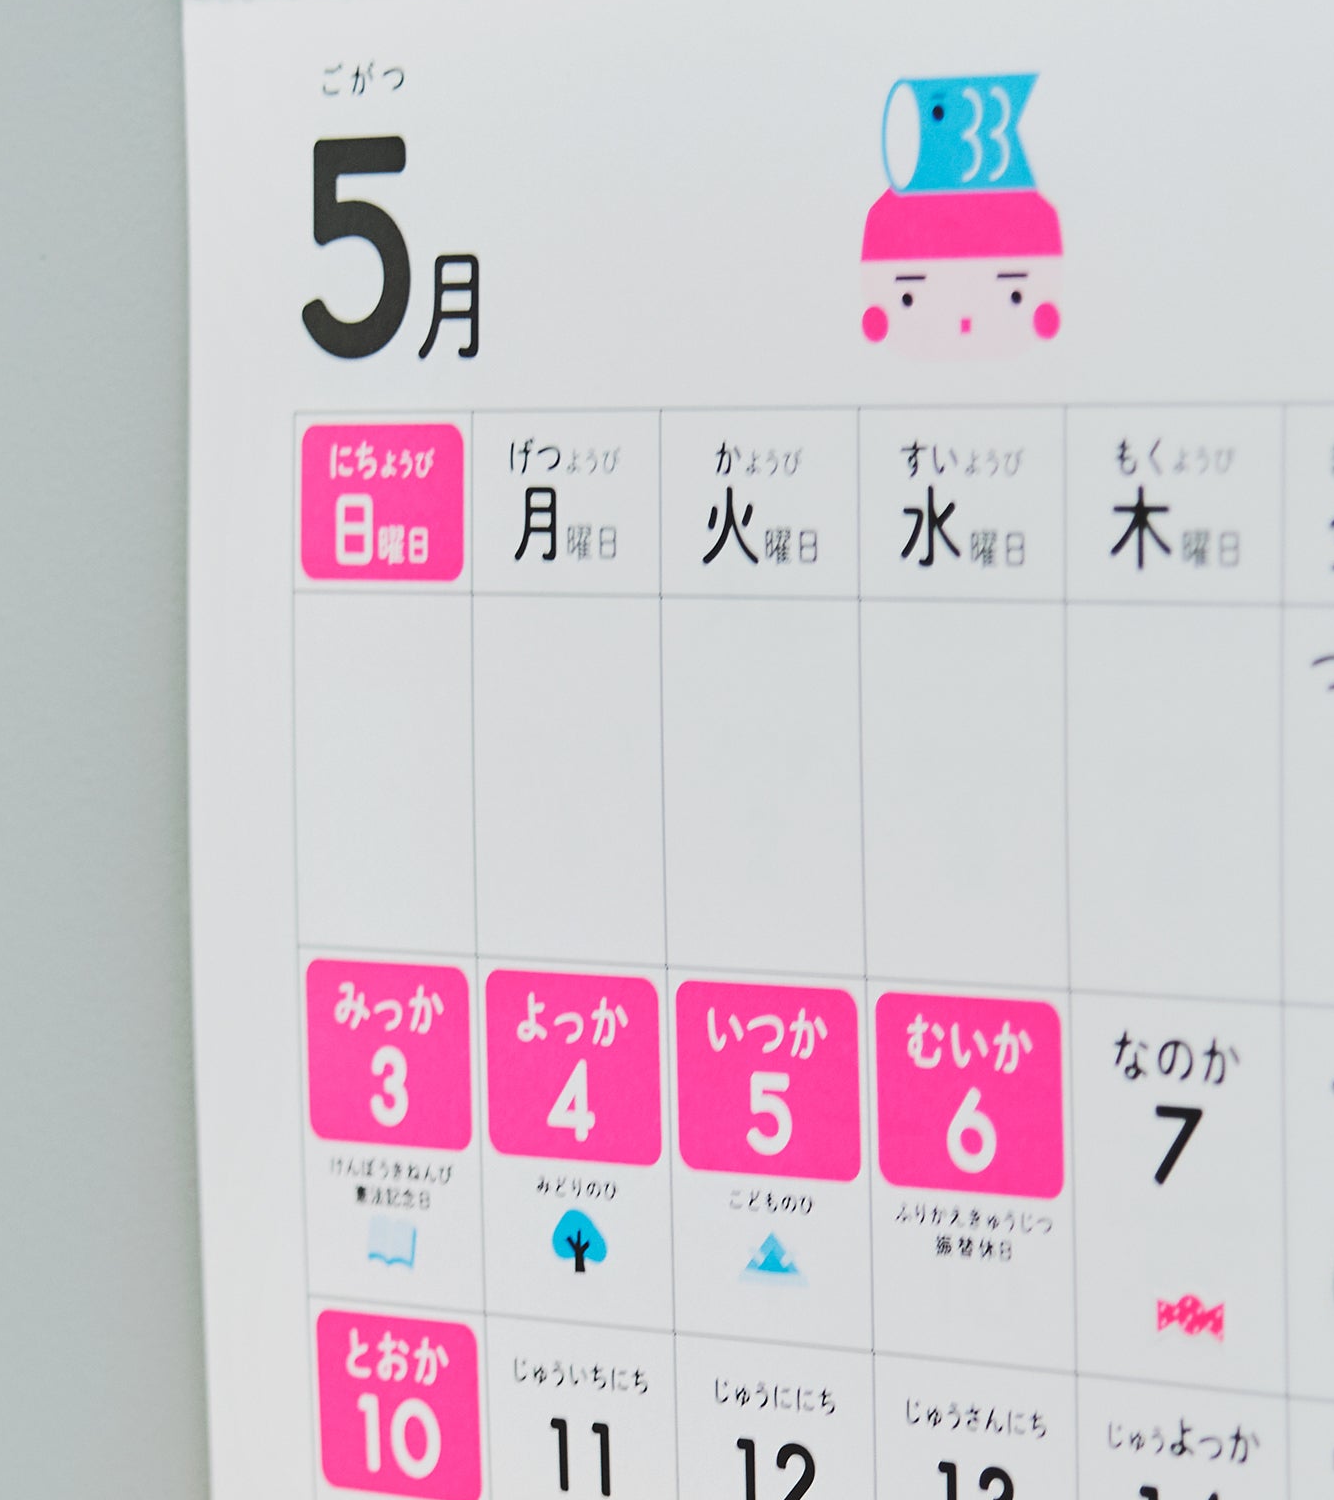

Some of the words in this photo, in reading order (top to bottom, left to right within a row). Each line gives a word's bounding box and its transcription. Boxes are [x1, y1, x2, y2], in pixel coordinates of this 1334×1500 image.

[322, 62, 405, 96] ごがつ
[301, 135, 480, 360] 5月
[329, 440, 435, 480] にちようび
[510, 438, 620, 474] げつようび
[716, 441, 802, 476] かようび
[901, 440, 1024, 478] すいようび
[1116, 438, 1236, 476] もくようび
[514, 486, 616, 562] 月曜日
[702, 486, 817, 565] 火曜日
[901, 485, 1024, 568] 水曜日
[1110, 485, 1237, 570] 木曜日
[334, 981, 444, 1034] みっか
[516, 991, 629, 1047] よっか
[707, 1007, 828, 1060] いつか
[906, 1013, 1033, 1074] むいか
[1114, 1031, 1239, 1085] なのか
[370, 1045, 409, 1127] 3
[546, 1058, 596, 1142] 4
[746, 1071, 793, 1156] 5
[946, 1086, 997, 1174] 6
[1154, 1104, 1203, 1186] 7
[345, 1328, 449, 1386] とおか
[514, 1359, 648, 1394] じゅういちにち
[715, 1379, 835, 1415] じゅうににち
[906, 1399, 1046, 1438] じゅうさんにち
[357, 1392, 441, 1479] 10
[550, 1417, 611, 1497] 11
[1109, 1418, 1260, 1464] じゅうよっか
